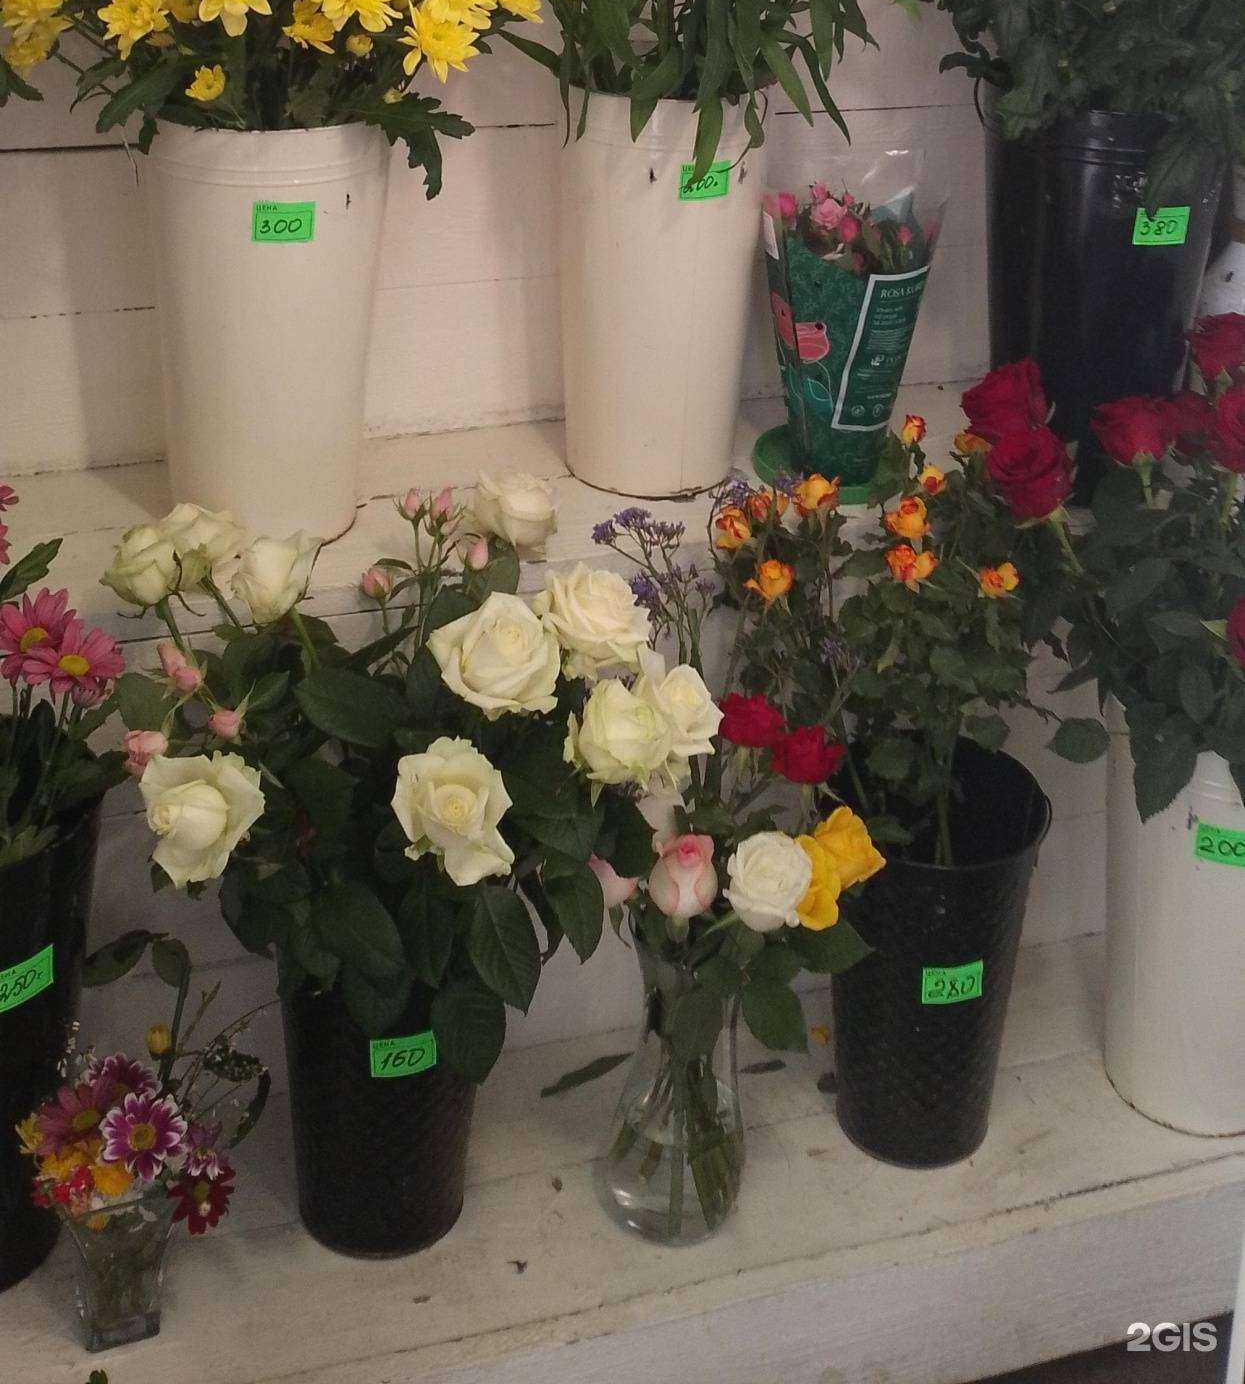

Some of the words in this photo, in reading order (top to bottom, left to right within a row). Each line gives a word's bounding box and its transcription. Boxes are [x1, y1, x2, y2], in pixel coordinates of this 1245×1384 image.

[259, 218, 303, 234] 300
[1139, 219, 1178, 236] 380
[927, 974, 977, 1001] 280
